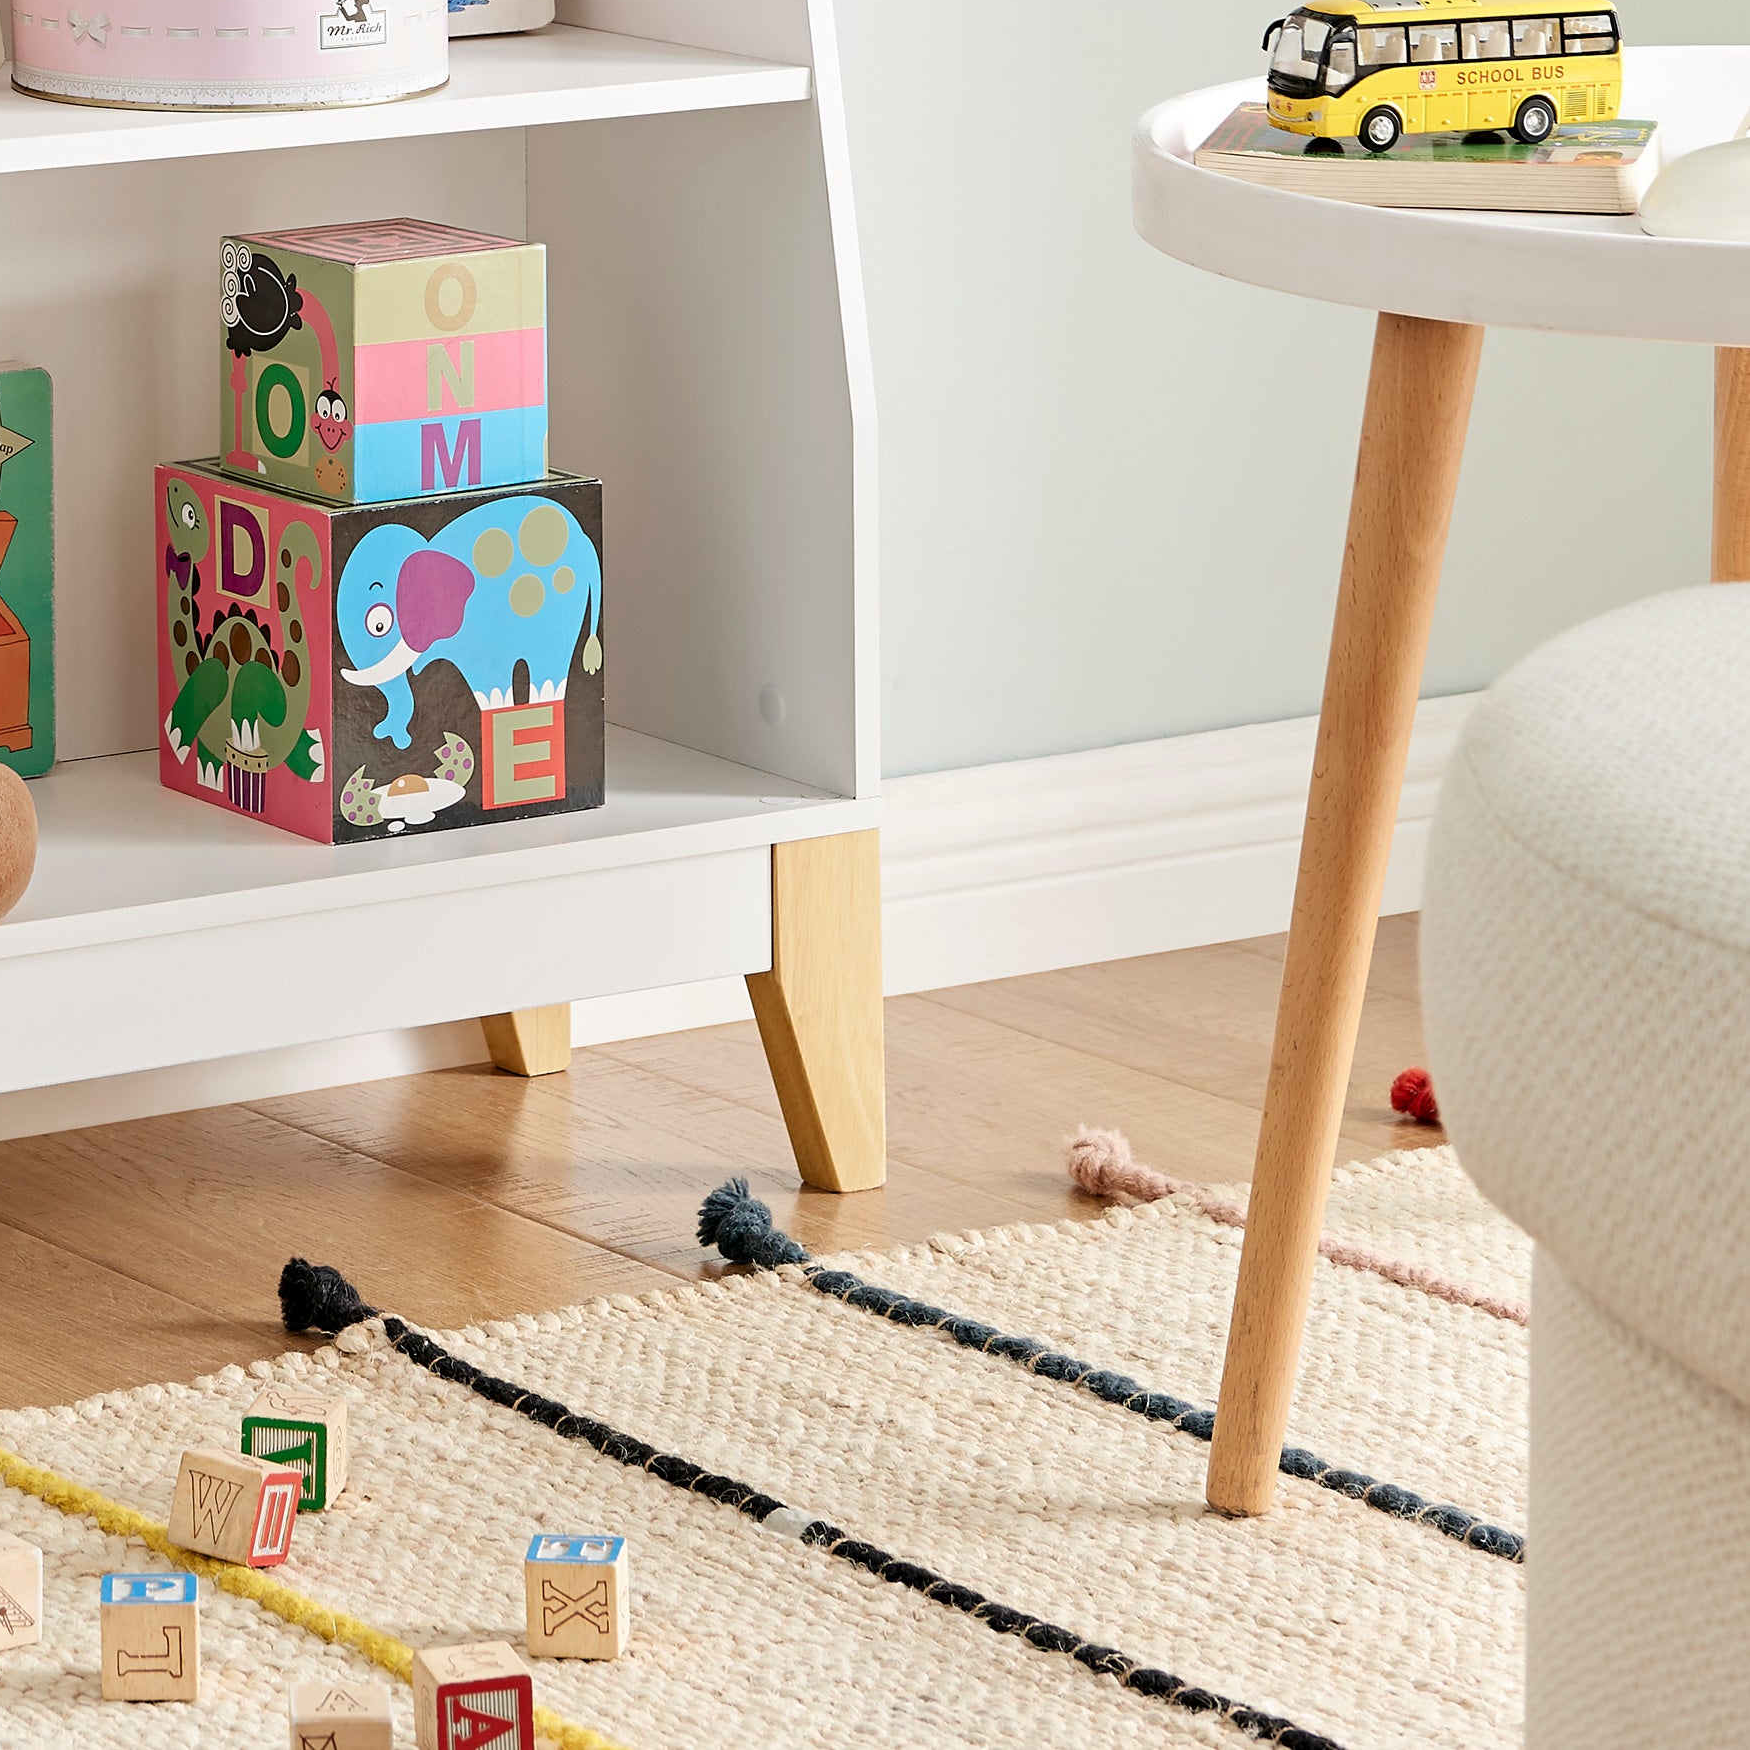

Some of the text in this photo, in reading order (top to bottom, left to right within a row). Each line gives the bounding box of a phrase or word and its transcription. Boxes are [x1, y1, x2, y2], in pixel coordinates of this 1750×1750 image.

[327, 21, 382, 37] Mr. Rich
[1456, 65, 1564, 85] SCHOOL BUS
[424, 262, 477, 332] O
[255, 363, 306, 458] O
[426, 340, 475, 412] N
[421, 418, 482, 491] M
[219, 501, 265, 597] D
[493, 705, 556, 805] E
[189, 1469, 245, 1546] W
[541, 1579, 609, 1637] X
[117, 1625, 183, 1678] L
[452, 1695, 515, 1750] A
